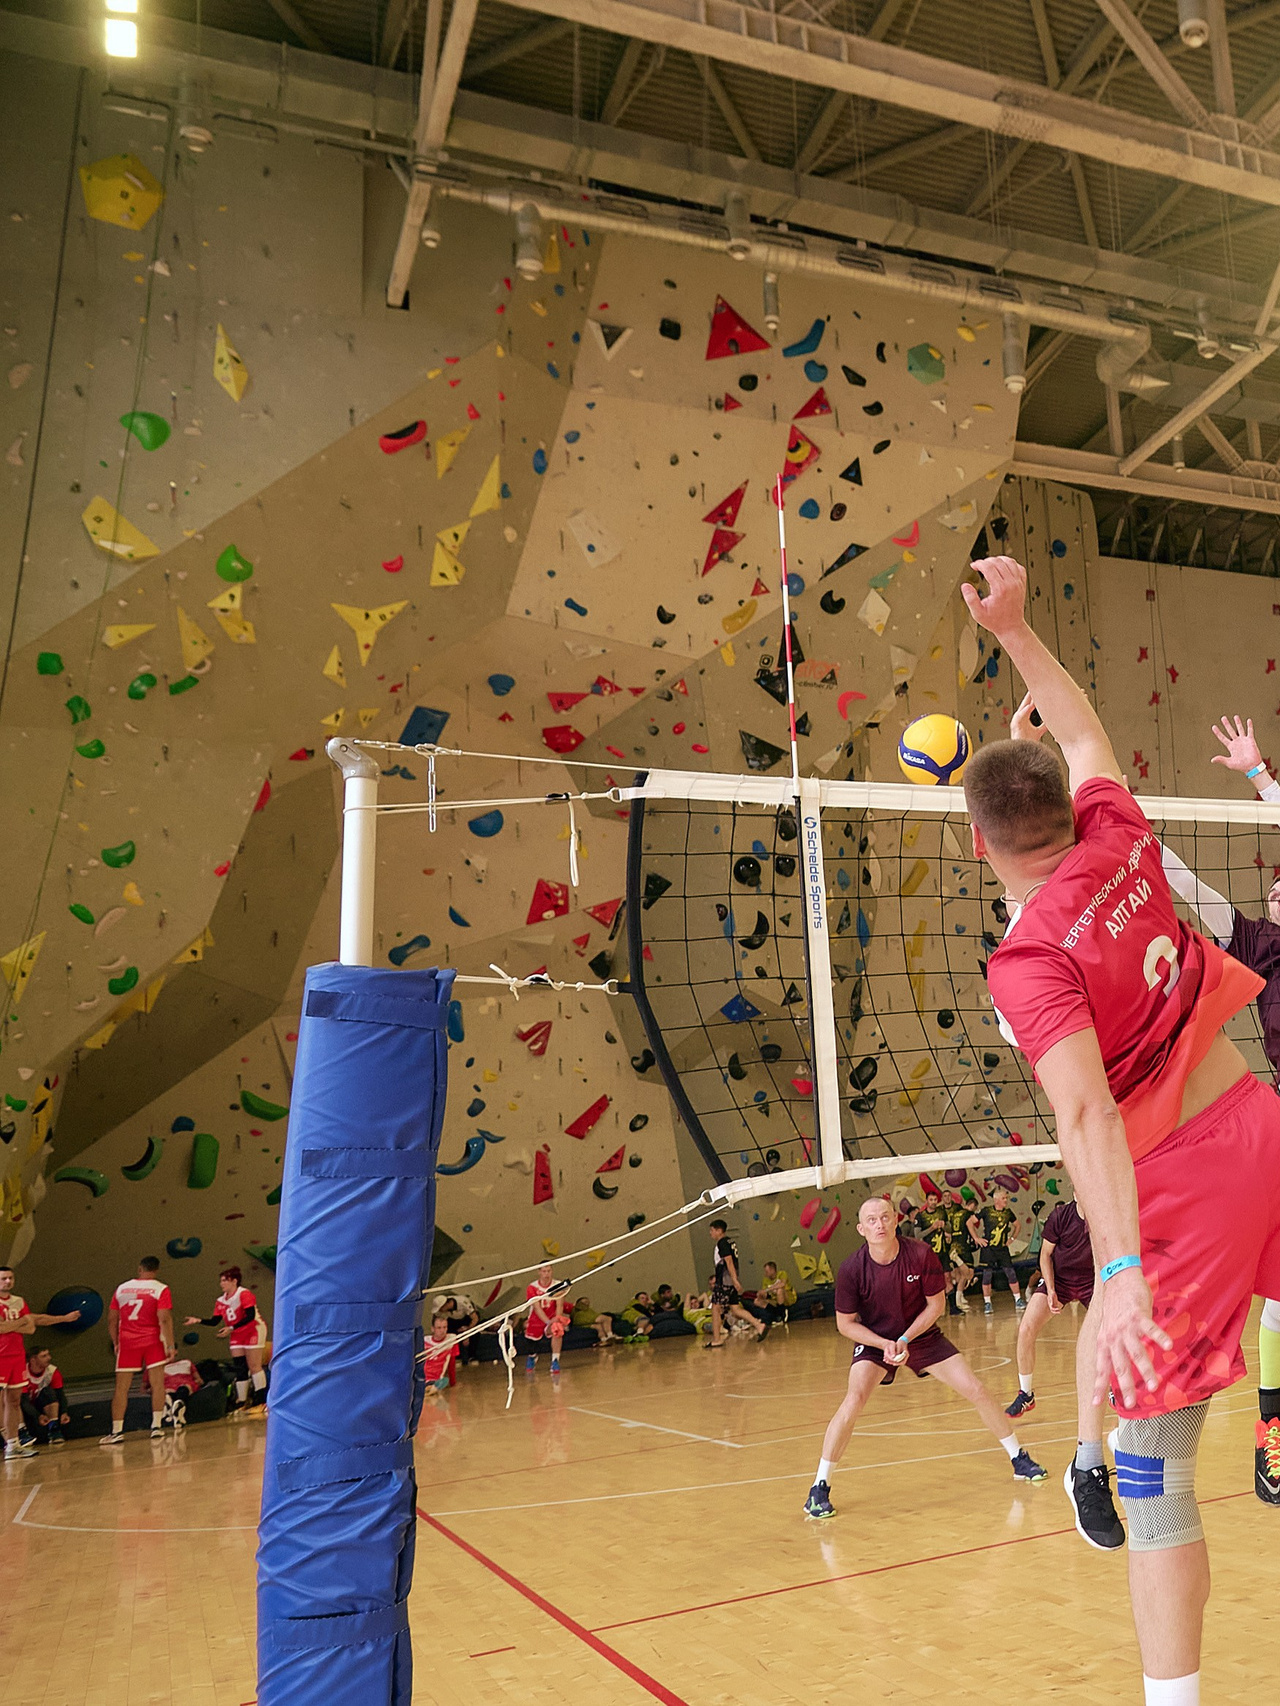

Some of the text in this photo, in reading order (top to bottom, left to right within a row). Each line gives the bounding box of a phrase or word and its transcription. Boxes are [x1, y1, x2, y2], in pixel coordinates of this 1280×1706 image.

[807, 831, 822, 929] Schelde Sports
[1105, 876, 1153, 940] АЛТАЙ
[128, 1299, 143, 1320] 7
[226, 1307, 237, 1321] 8
